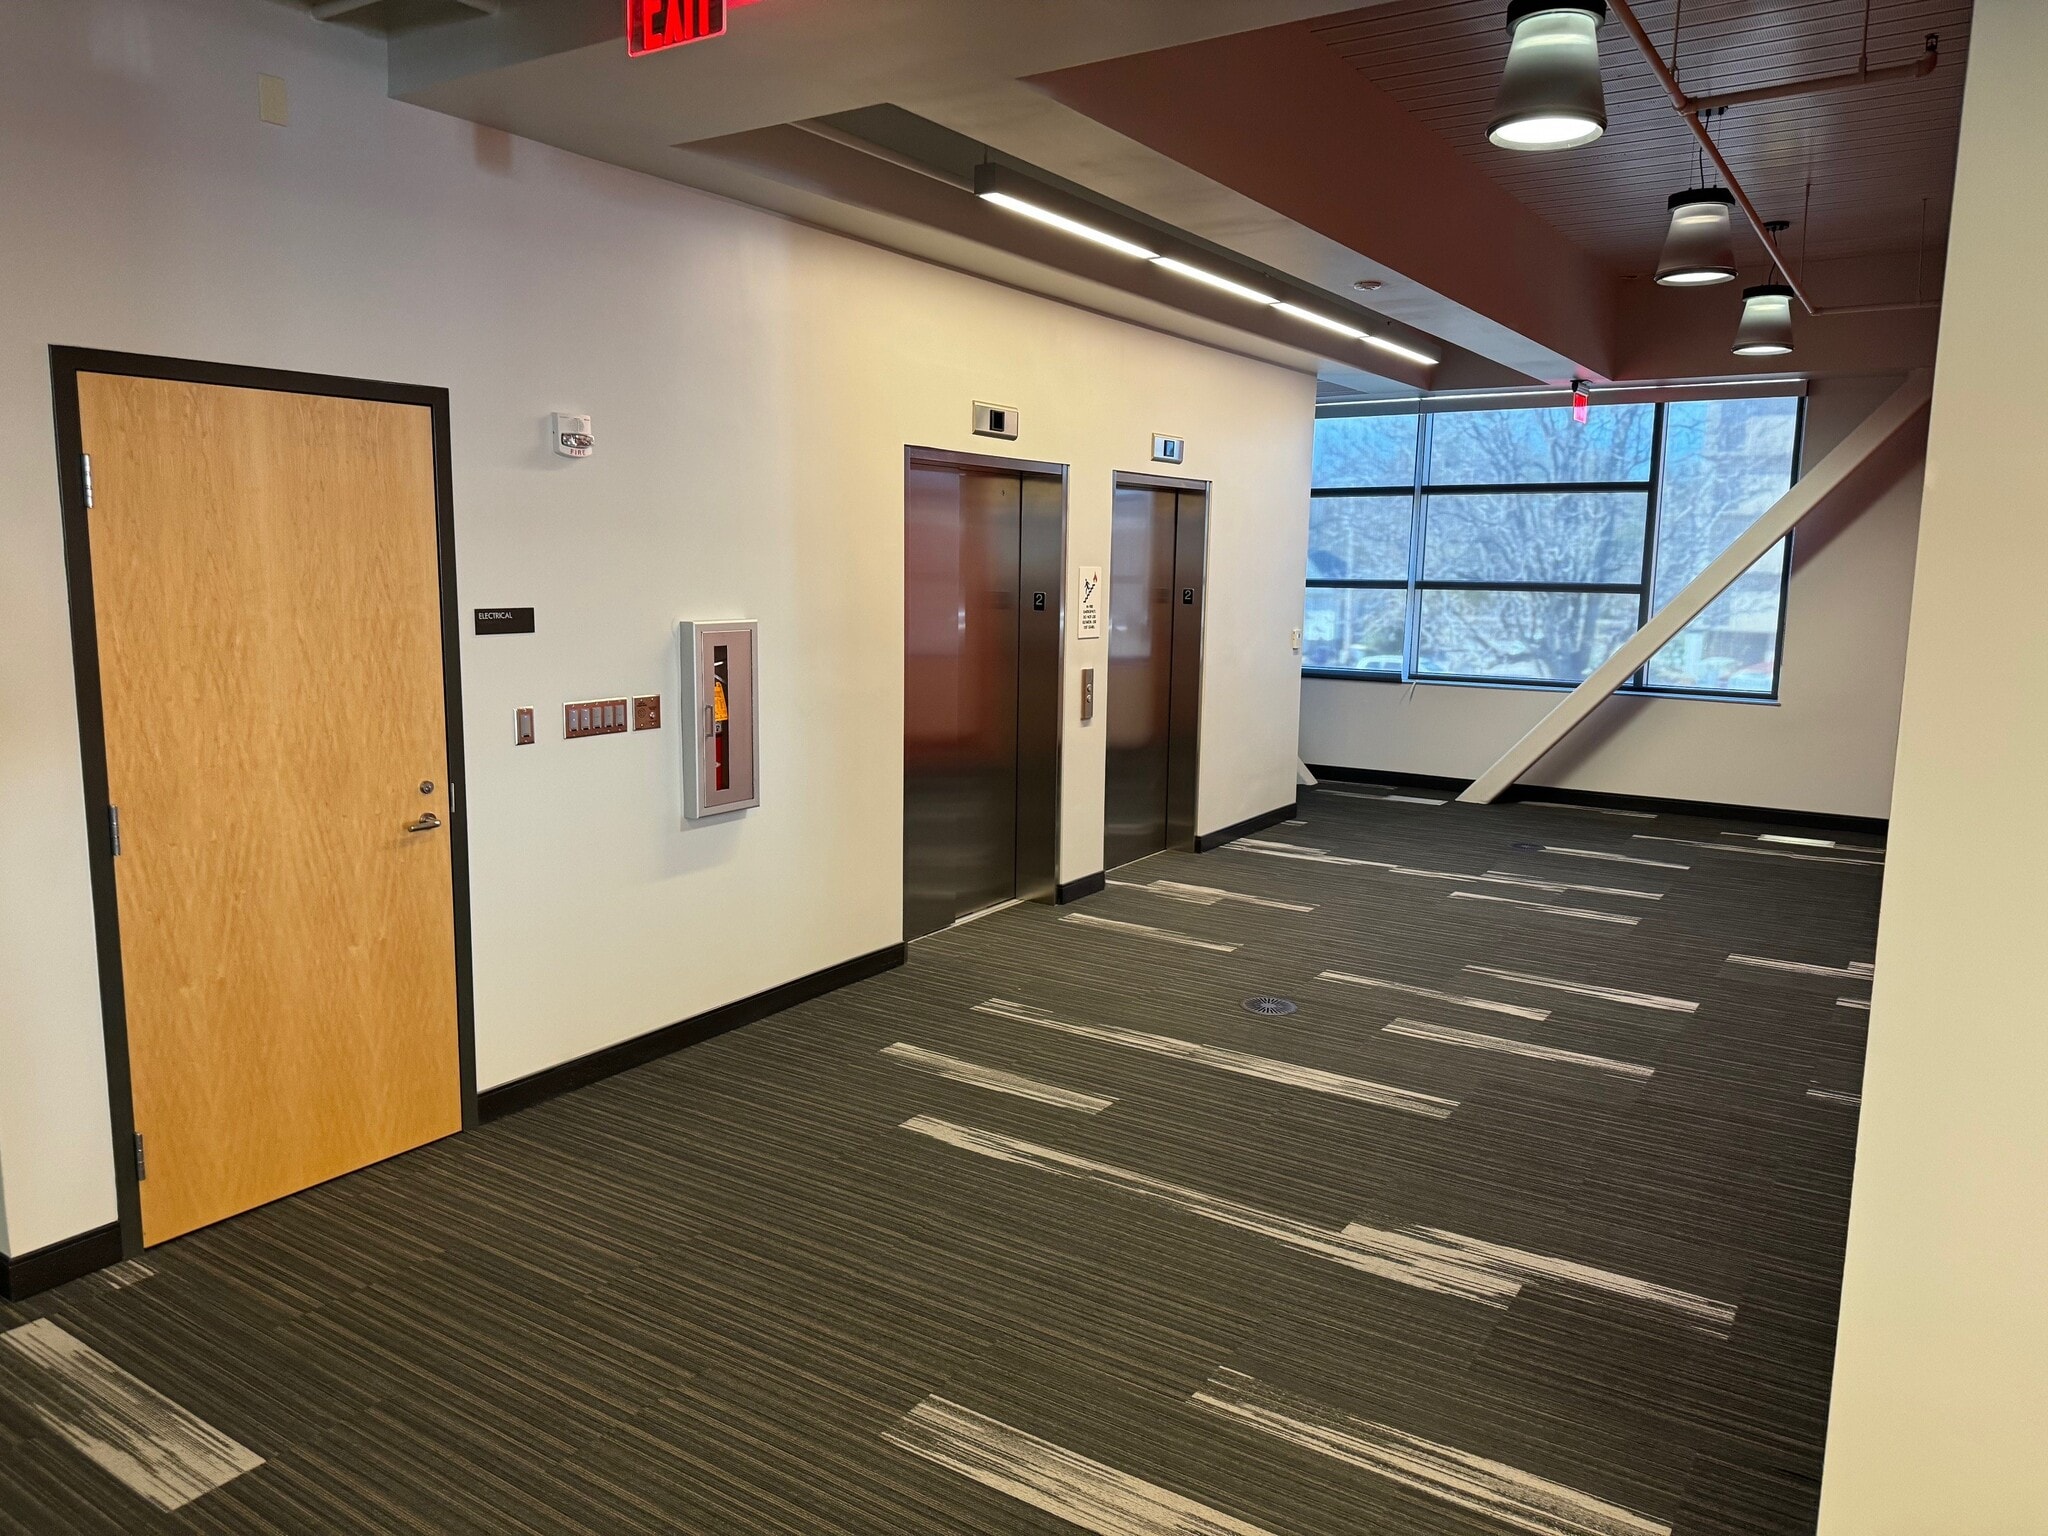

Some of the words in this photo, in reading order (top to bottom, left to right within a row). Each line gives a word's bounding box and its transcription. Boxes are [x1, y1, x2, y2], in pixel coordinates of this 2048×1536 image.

[570, 448, 586, 456] FIRE
[1035, 593, 1043, 606] 2
[1184, 589, 1192, 600] 2
[478, 611, 513, 620] ELECTRICAL
